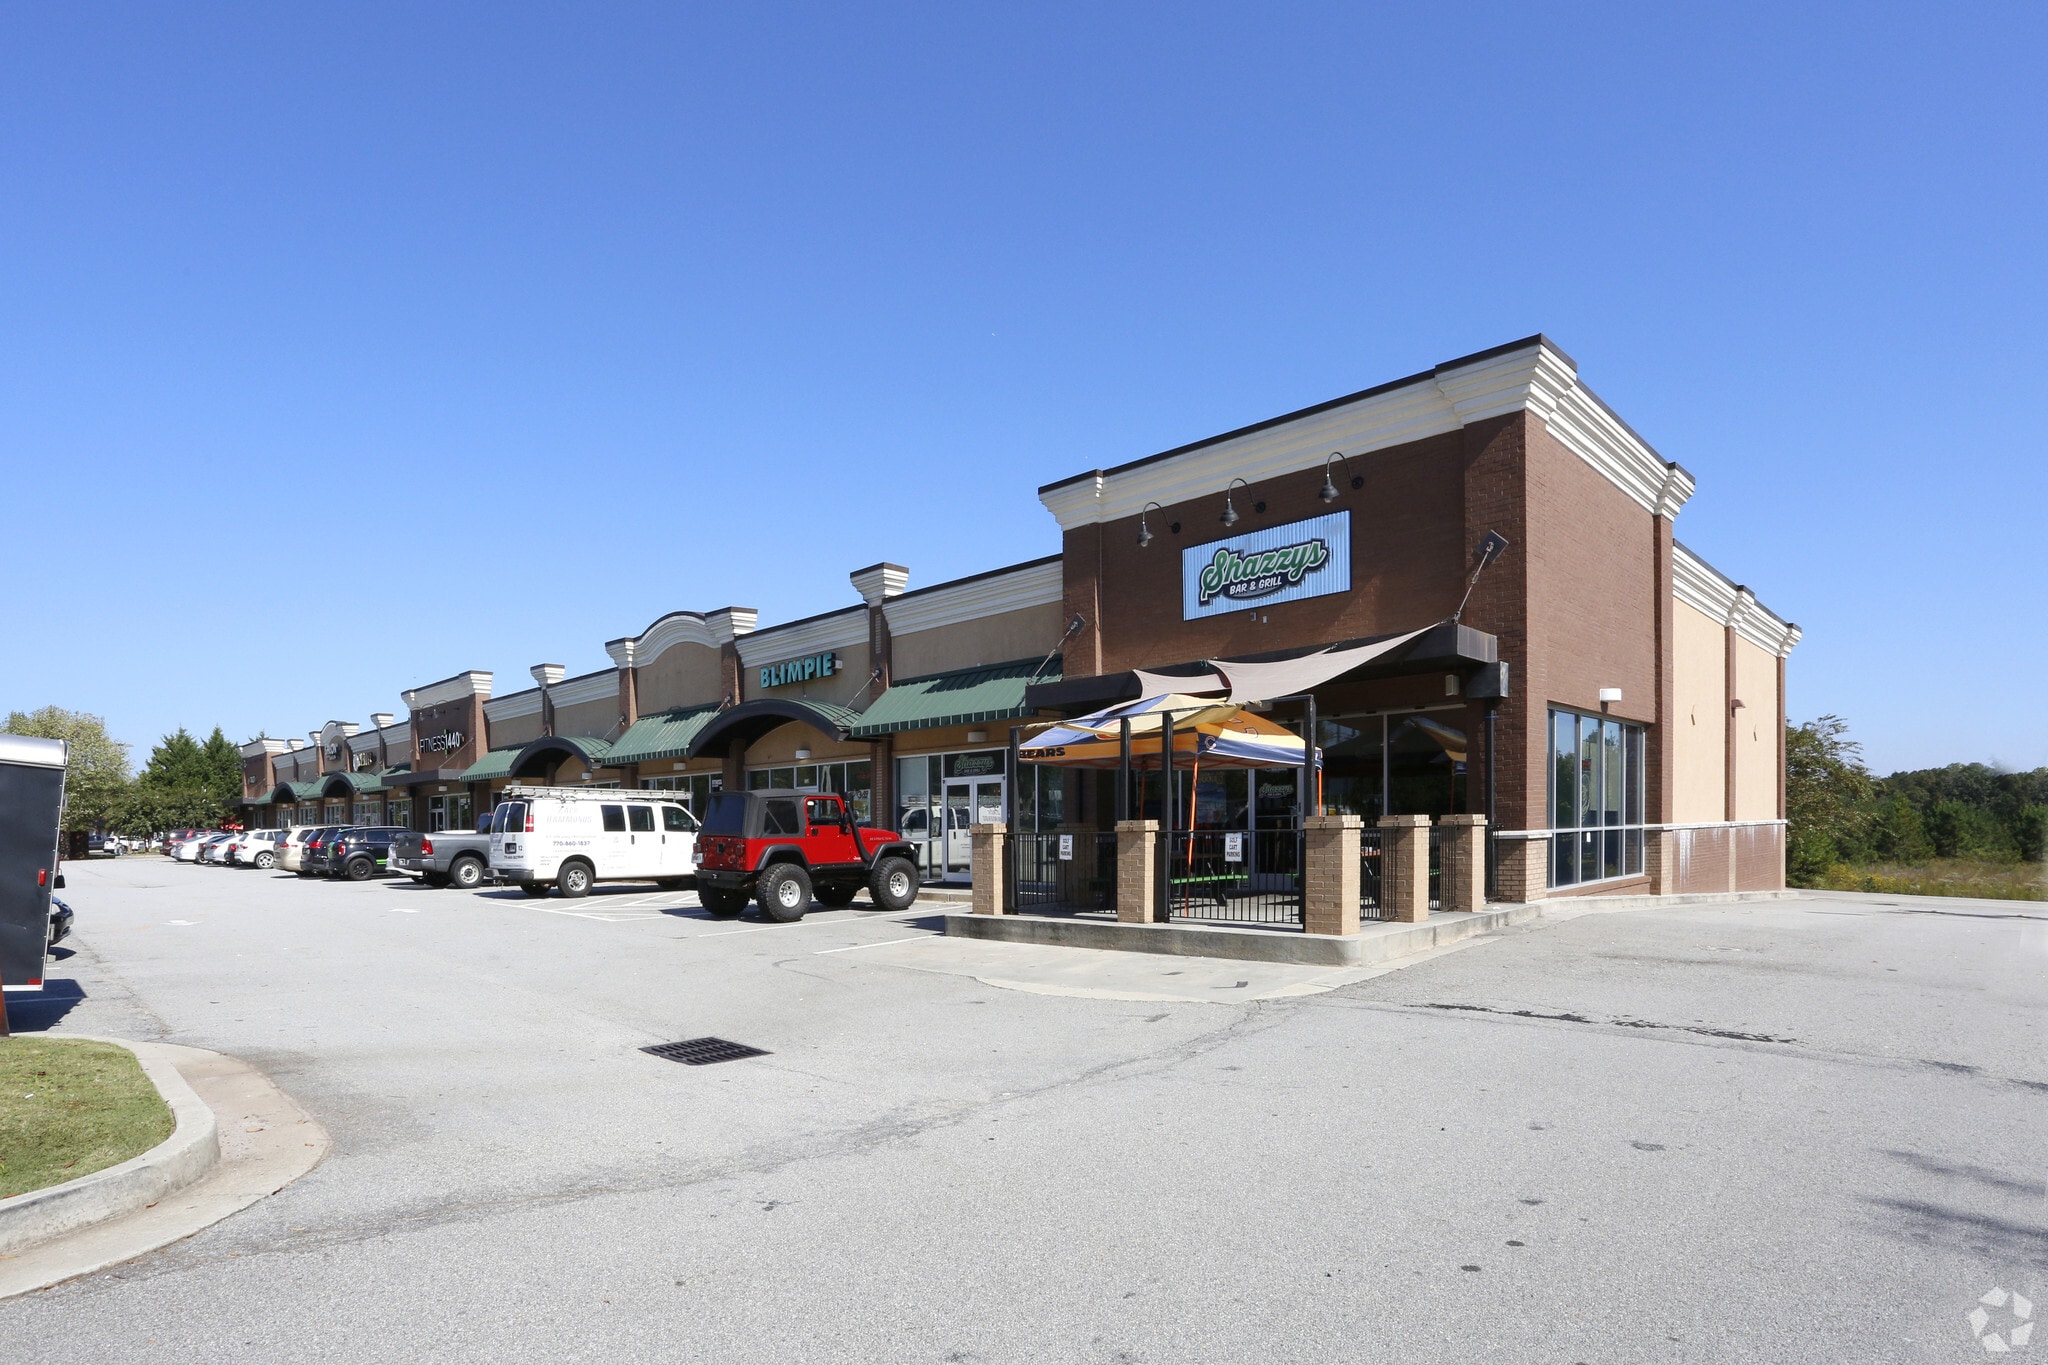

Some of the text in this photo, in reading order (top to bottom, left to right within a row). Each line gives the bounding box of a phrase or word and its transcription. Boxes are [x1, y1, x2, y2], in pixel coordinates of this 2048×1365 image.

[1201, 541, 1327, 601] Shazzys
[1229, 576, 1282, 595] BAR & GRILL
[760, 652, 834, 689] BLIMPIE
